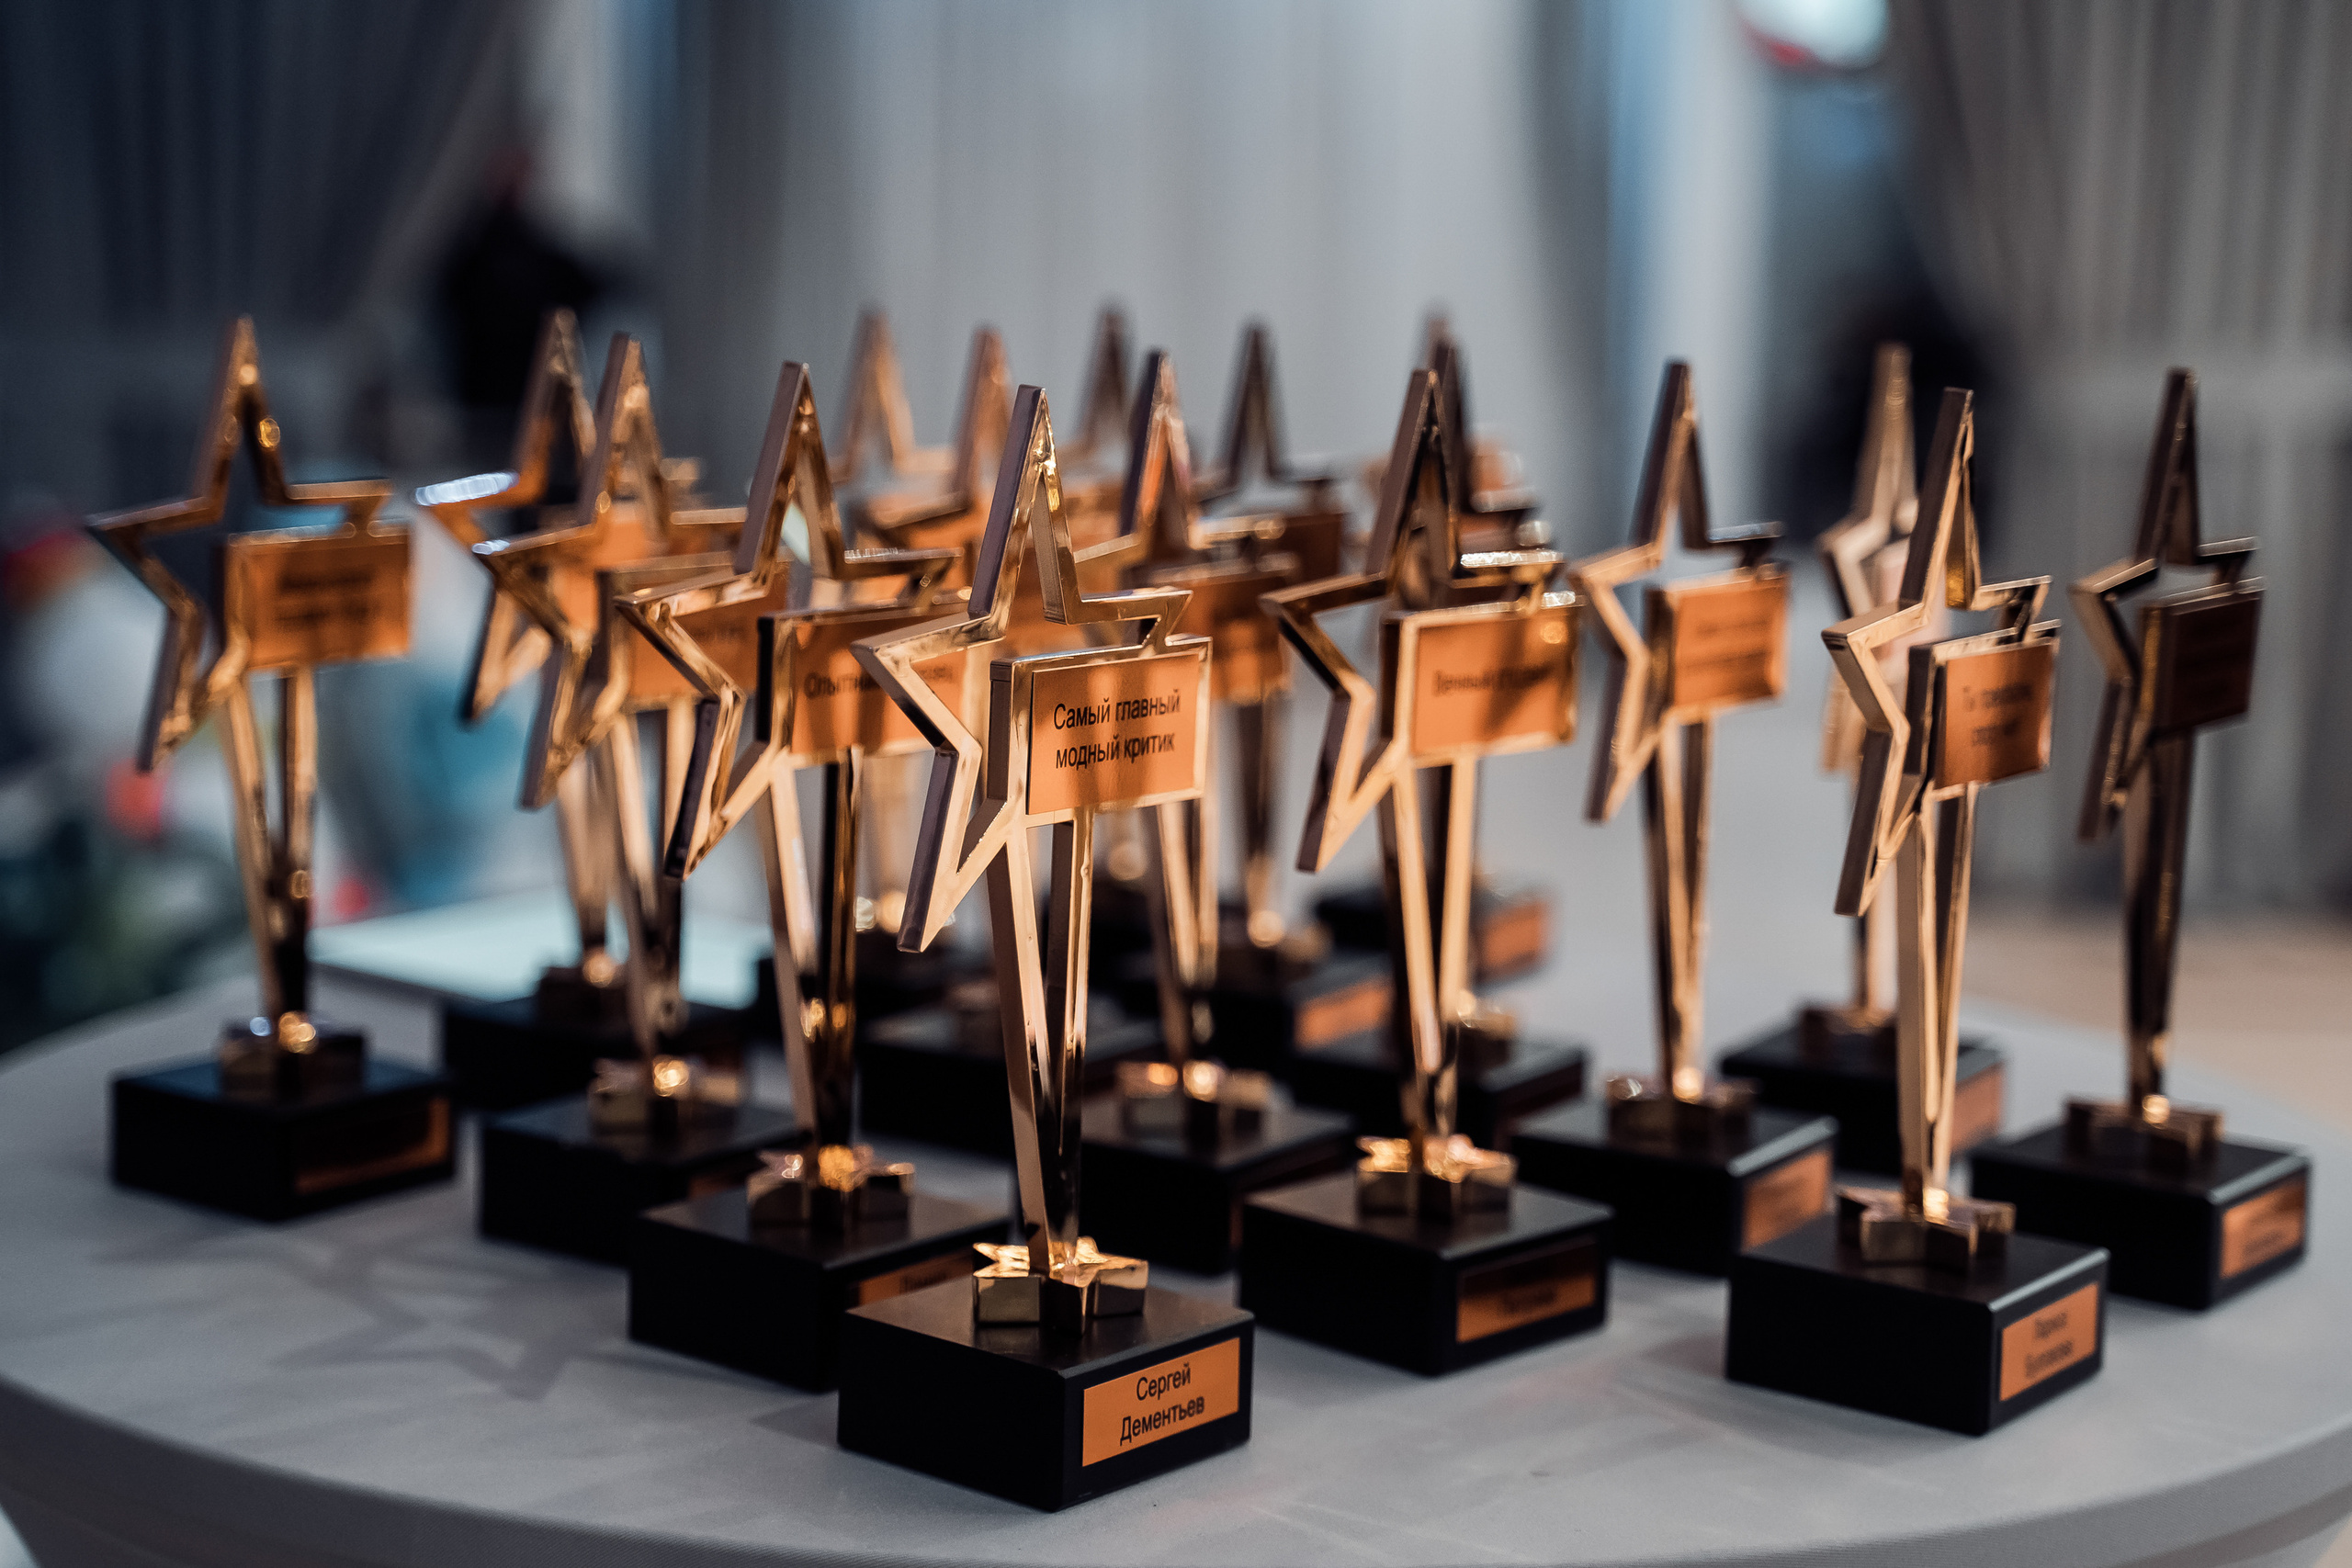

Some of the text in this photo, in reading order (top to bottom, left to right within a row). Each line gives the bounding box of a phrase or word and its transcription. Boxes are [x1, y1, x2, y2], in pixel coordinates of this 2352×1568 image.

[1053, 688, 1182, 730] Самый главный
[1056, 731, 1176, 771] модный критик
[1136, 1361, 1192, 1402] Сергей
[1120, 1395, 1205, 1447] Дементьев
